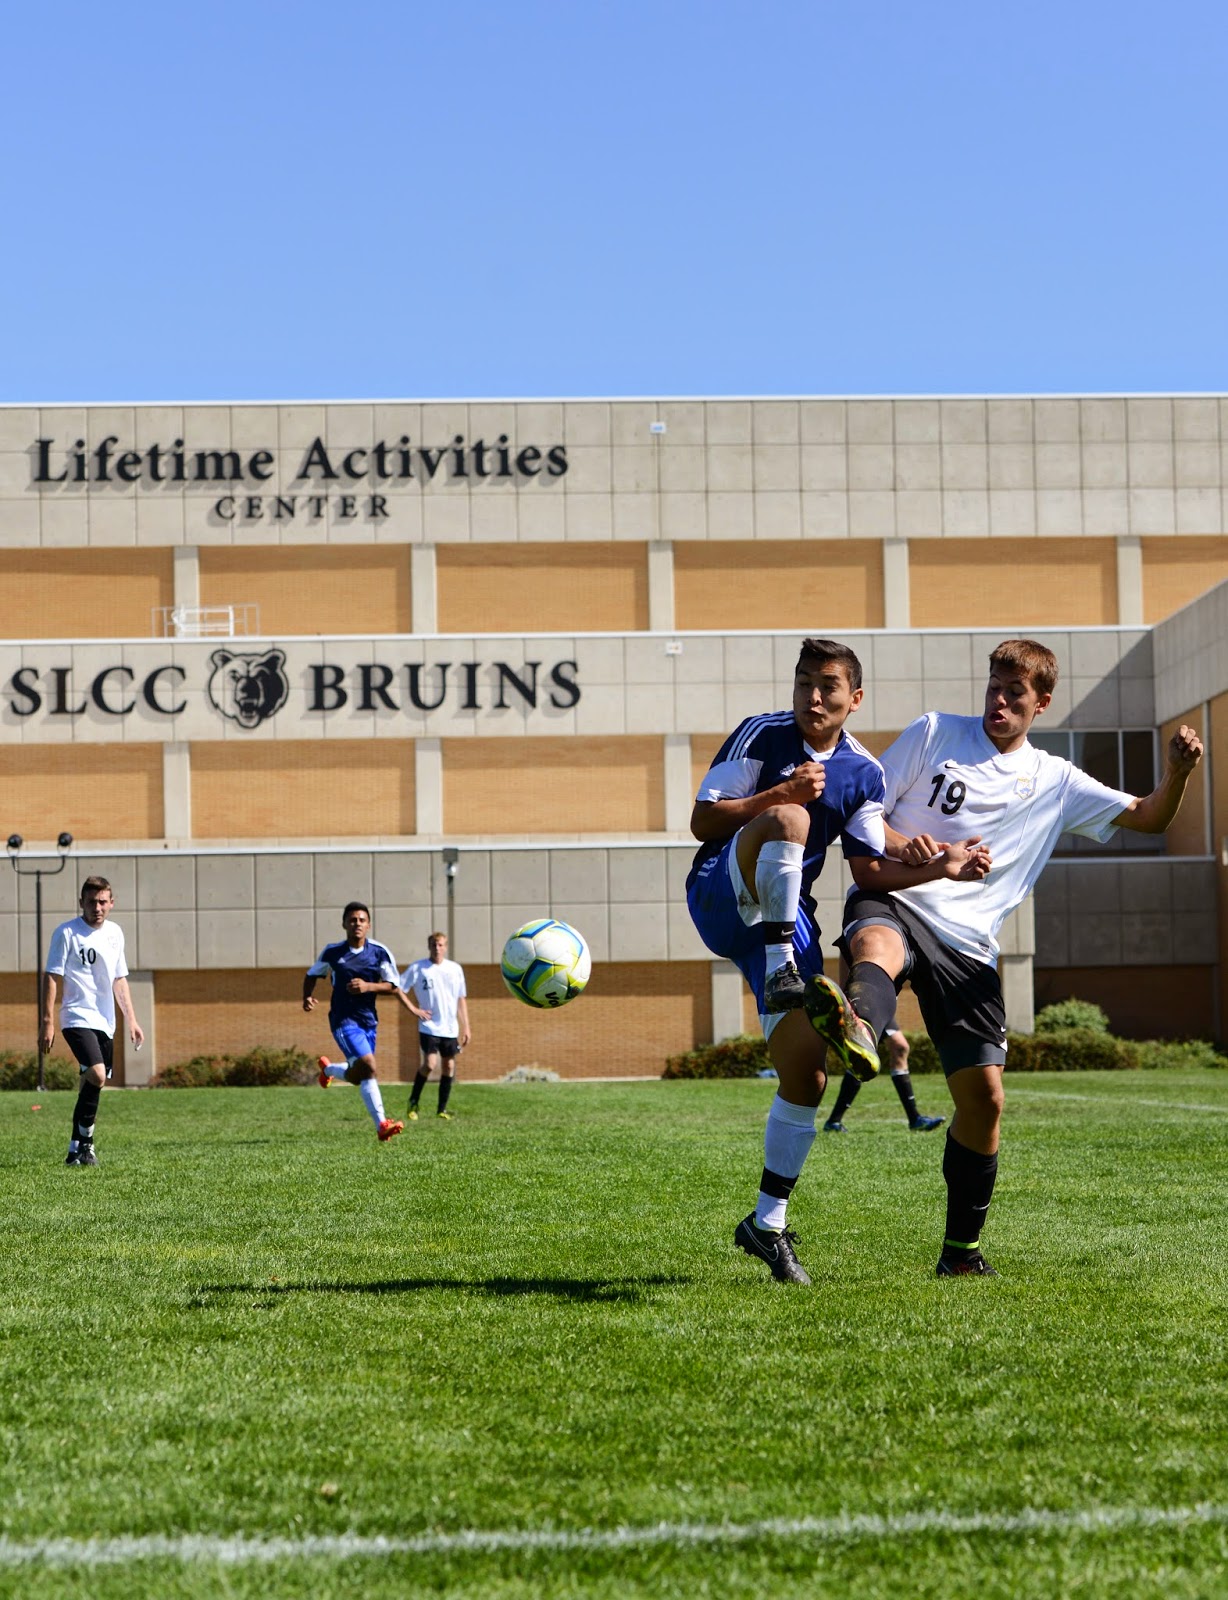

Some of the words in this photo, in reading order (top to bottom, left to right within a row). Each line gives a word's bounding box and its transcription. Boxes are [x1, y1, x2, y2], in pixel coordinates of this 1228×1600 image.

[33, 436, 274, 482] Lifetime
[297, 435, 568, 479] Activities
[215, 495, 389, 519] CENTER
[10, 666, 187, 716] SLCC
[308, 659, 580, 711] BRUINS
[927, 773, 966, 816] 19
[79, 948, 97, 965] 10
